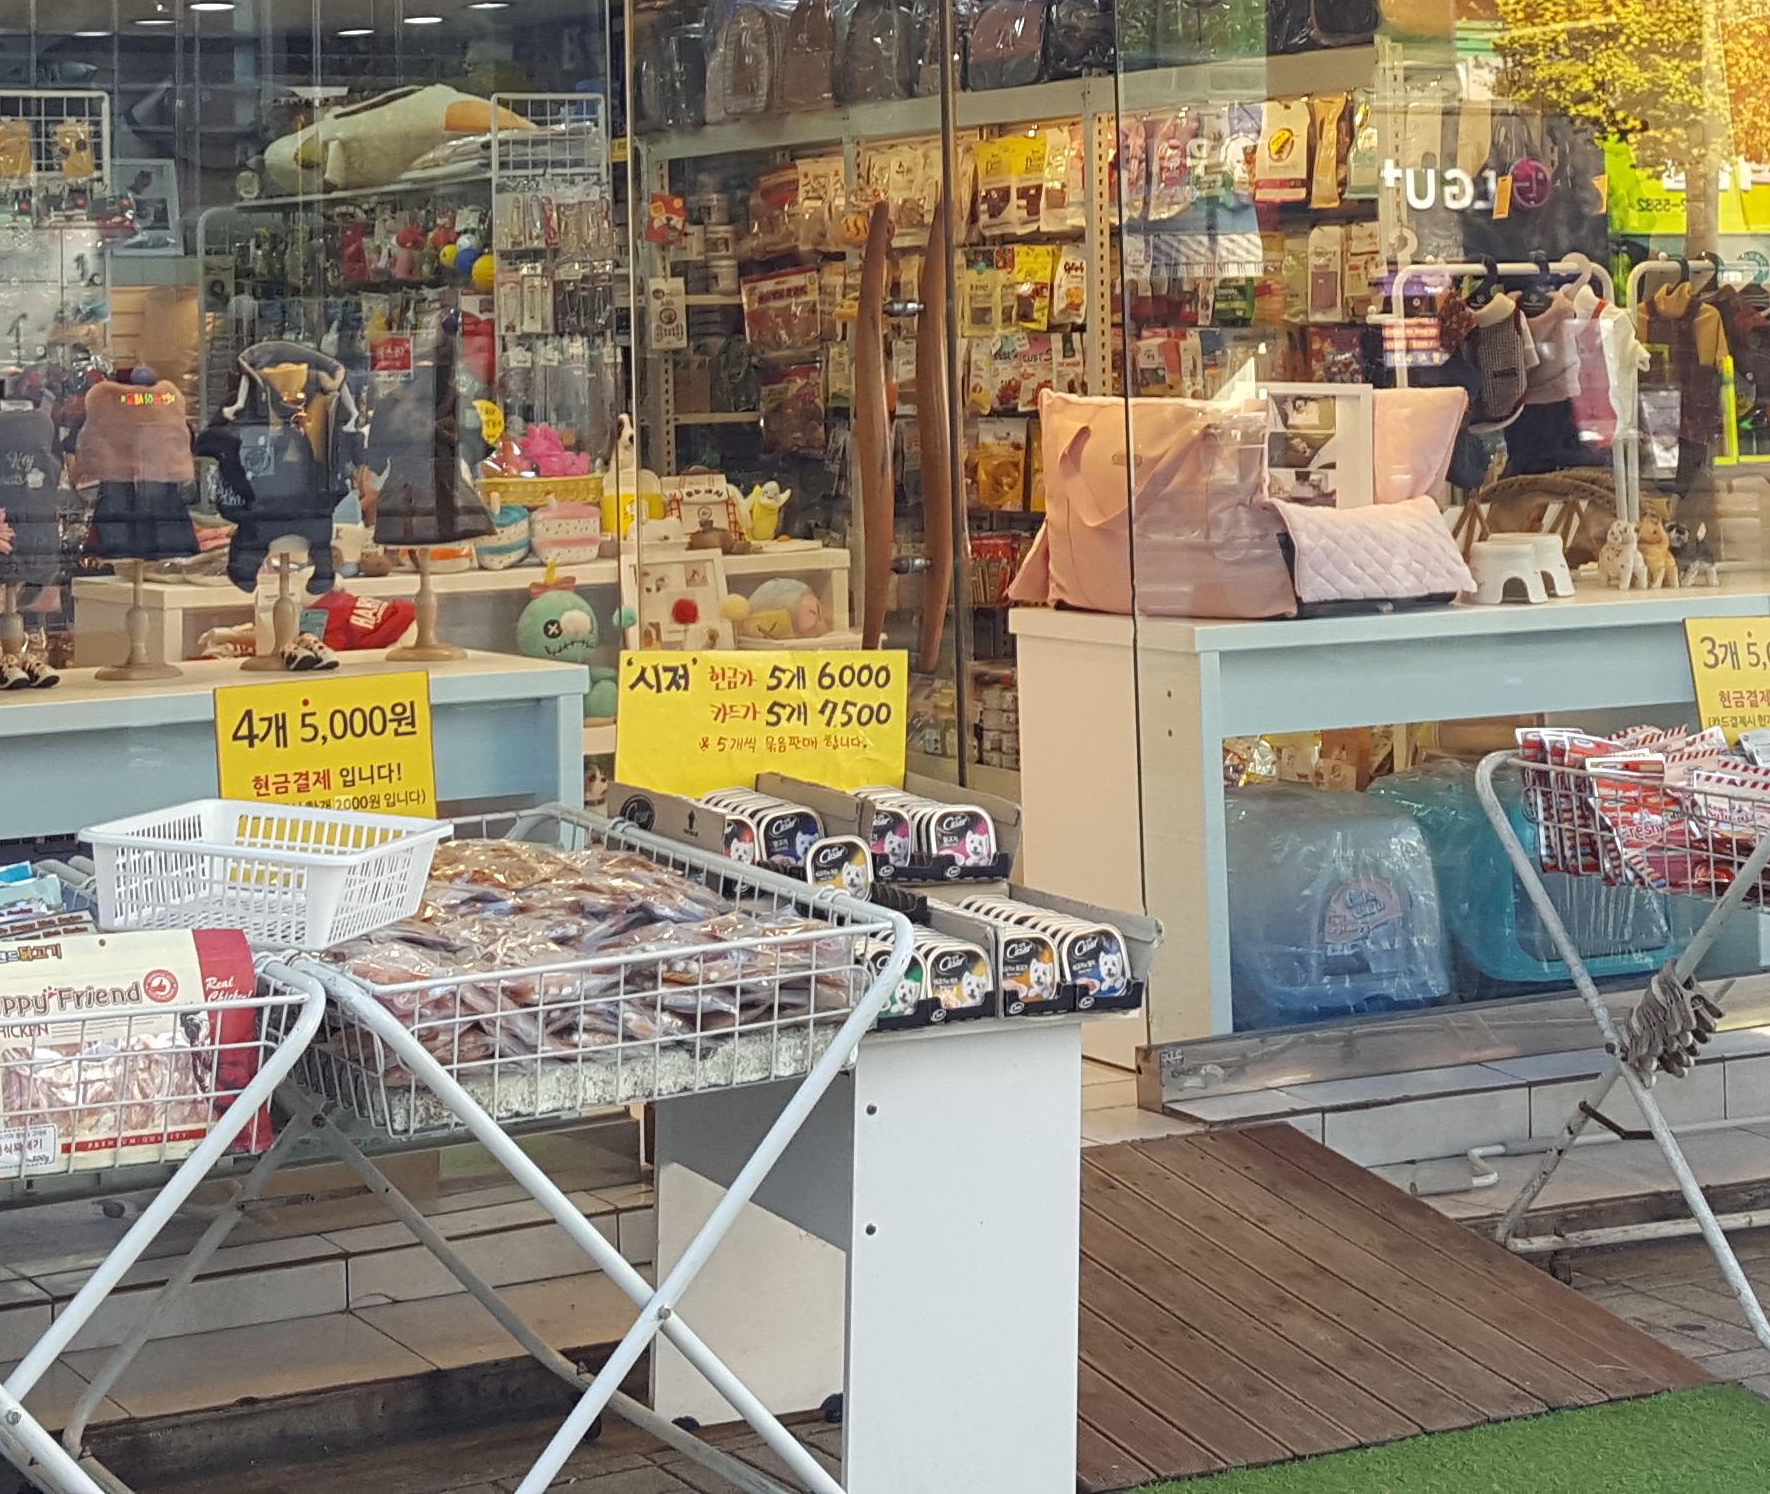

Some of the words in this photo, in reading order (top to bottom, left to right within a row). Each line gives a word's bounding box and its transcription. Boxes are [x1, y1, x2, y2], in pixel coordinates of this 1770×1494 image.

[1700, 636, 1742, 671] 3개
[766, 664, 806, 692] 5개
[232, 709, 288, 749] 4개
[301, 700, 417, 746] 5,000원
[766, 700, 808, 727] 5개
[252, 768, 331, 797] 현금결제
[339, 762, 402, 787] 입니다!
[383, 788, 427, 807] 입니다)
[56, 981, 142, 1010] Friend
[205, 976, 234, 990] Real
[87, 1137, 137, 1150] PREMUM
[141, 1132, 189, 1145] QUAITY
